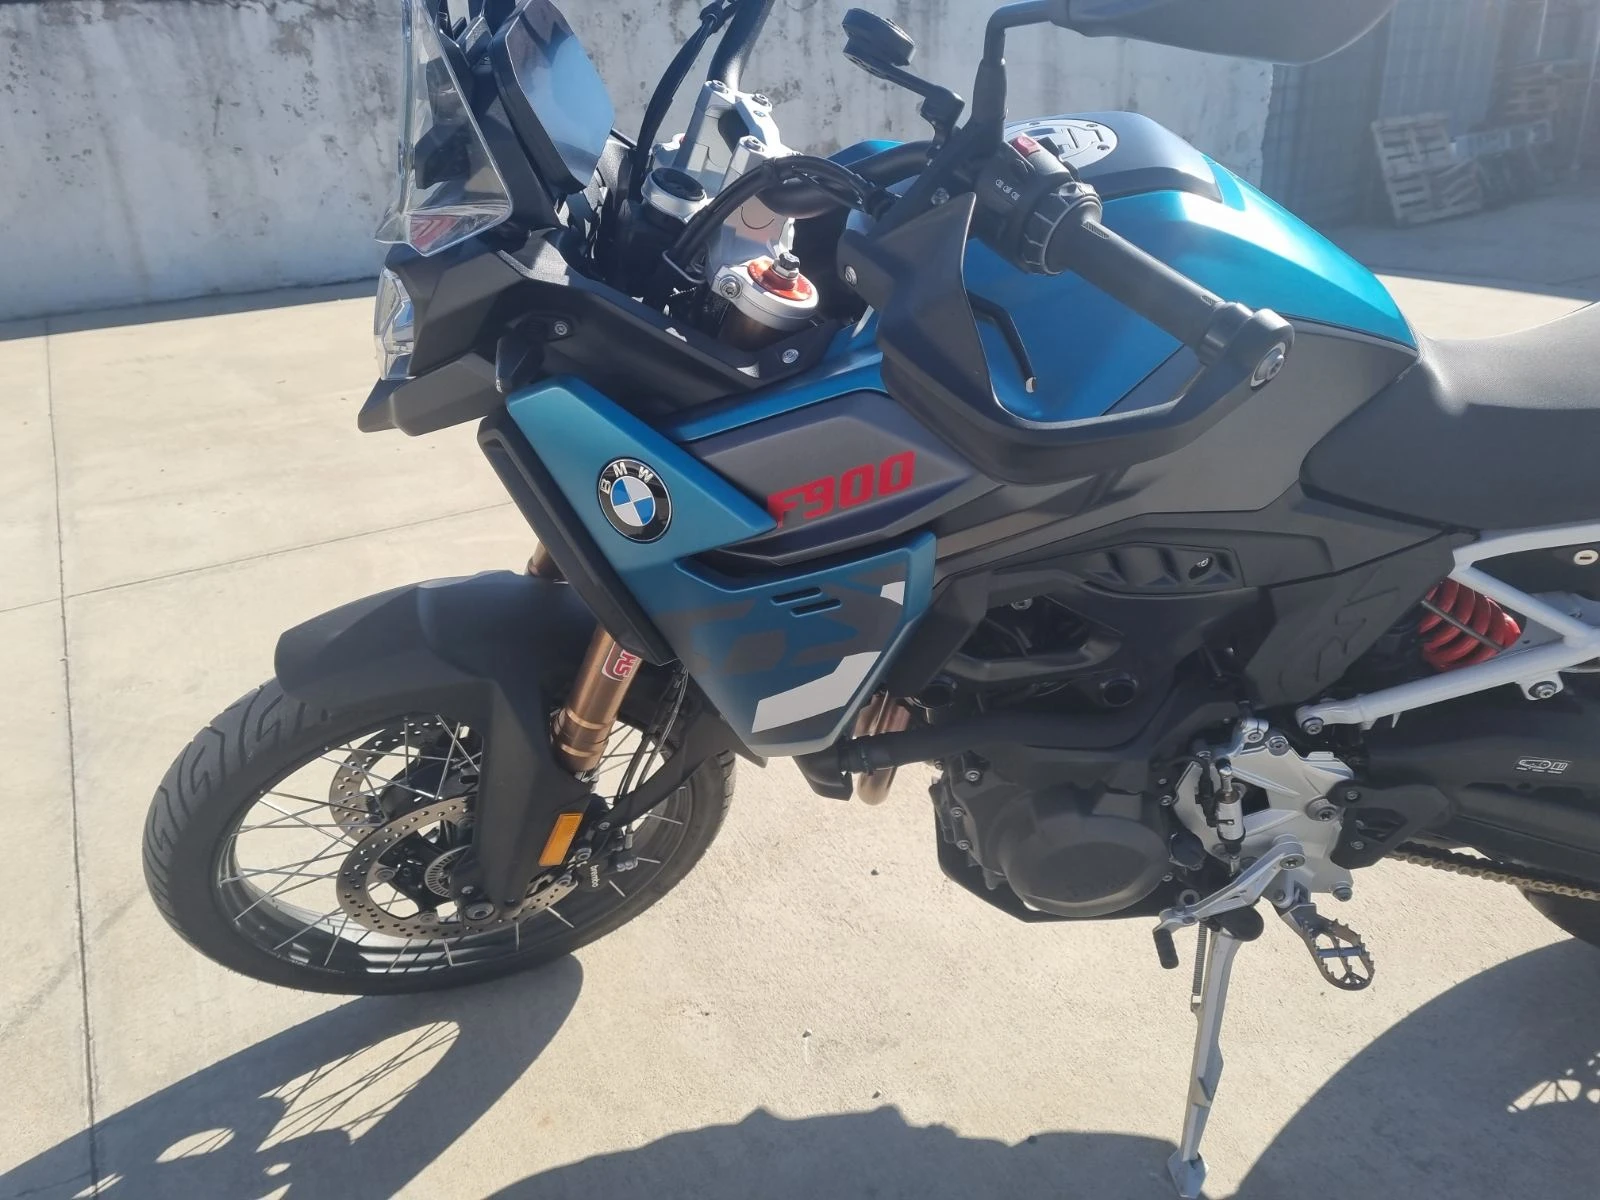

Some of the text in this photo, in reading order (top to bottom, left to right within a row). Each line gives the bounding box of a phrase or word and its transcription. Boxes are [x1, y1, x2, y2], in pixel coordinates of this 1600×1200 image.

[600, 462, 653, 494] BMW
[767, 450, 916, 528] F900
[590, 864, 600, 887] brembo
